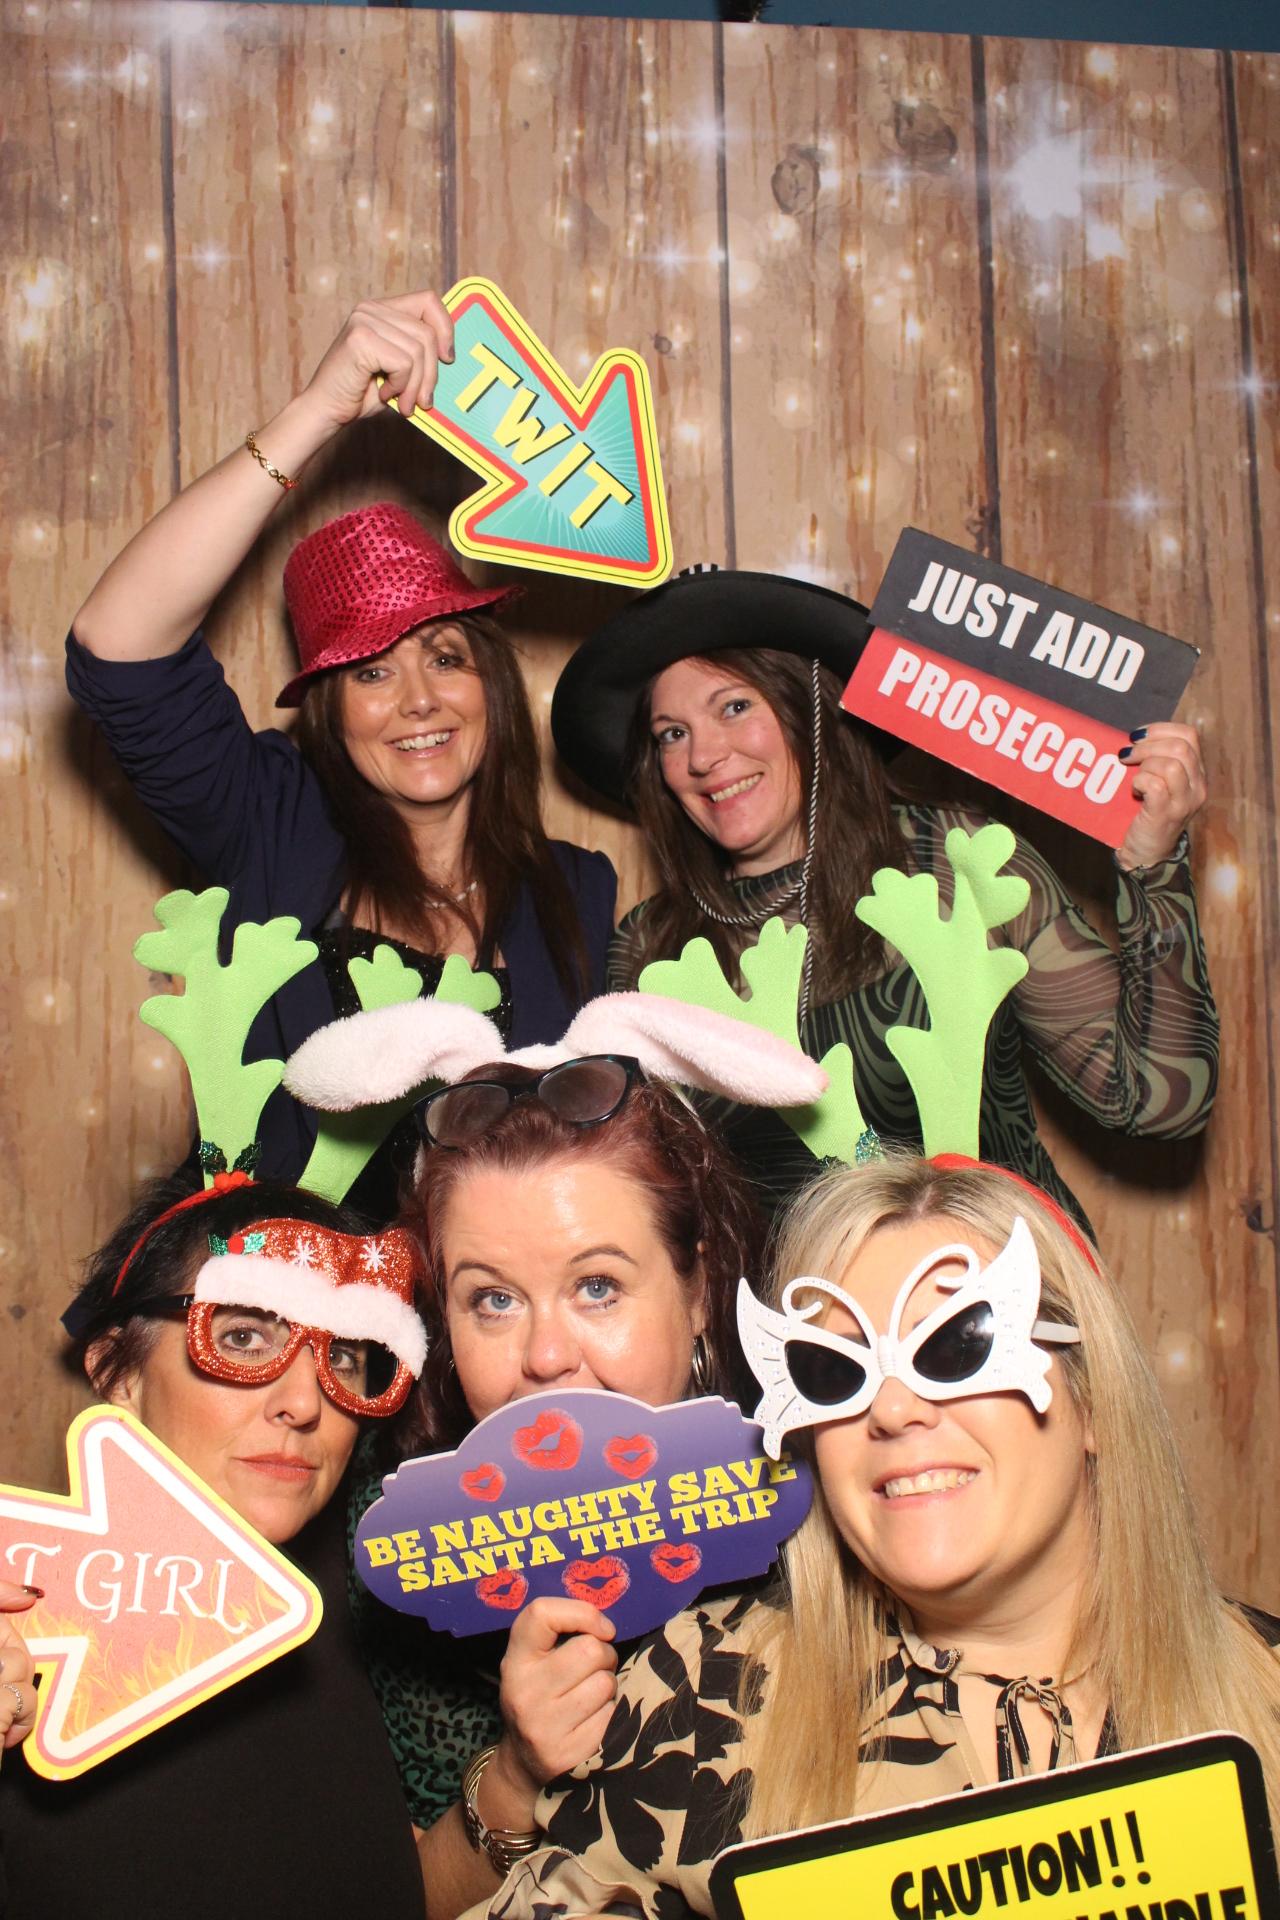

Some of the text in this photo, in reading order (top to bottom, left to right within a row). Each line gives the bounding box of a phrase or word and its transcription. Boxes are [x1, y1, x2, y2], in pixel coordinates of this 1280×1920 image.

[455, 342, 635, 529] TWIT
[907, 561, 1145, 693] JUST ADD
[878, 647, 1128, 804] PROSECCO
[363, 1451, 797, 1568] BE NAUGHTY SAVE
[397, 1488, 779, 1592] SANTA THE TRIP
[75, 1548, 247, 1635] GIRL
[890, 1810, 1152, 1920] CAUTION!!
